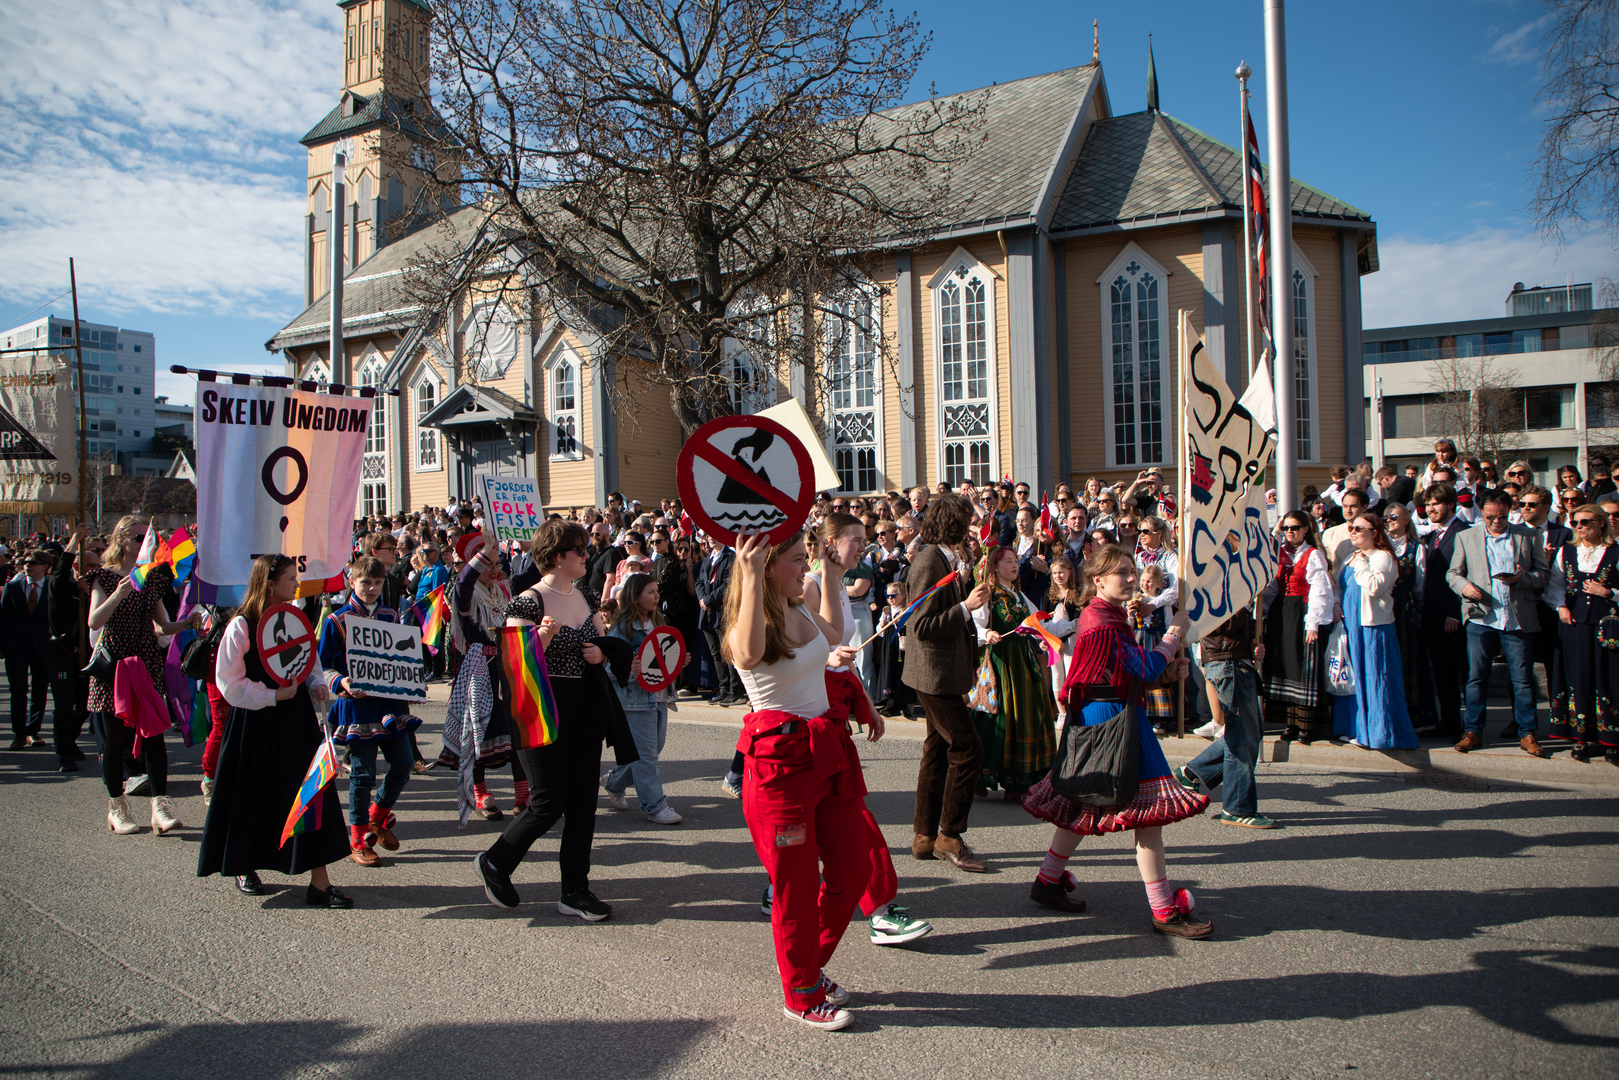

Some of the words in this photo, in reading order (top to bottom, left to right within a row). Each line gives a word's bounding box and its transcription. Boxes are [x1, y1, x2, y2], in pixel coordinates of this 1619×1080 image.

[0, 374, 55, 387] ENINGEN
[202, 390, 275, 426] SKEIV
[282, 397, 368, 433] UNGDOM
[6, 473, 34, 485] JUNI
[40, 472, 72, 485] 1919
[486, 479, 533, 493] FJORDEN
[496, 492, 508, 500] ER
[513, 494, 528, 502] FOR
[493, 501, 537, 516] FOLK
[495, 514, 539, 527] FISK
[352, 626, 393, 650] REDD
[349, 659, 425, 684] FØRDEFJORDEN
